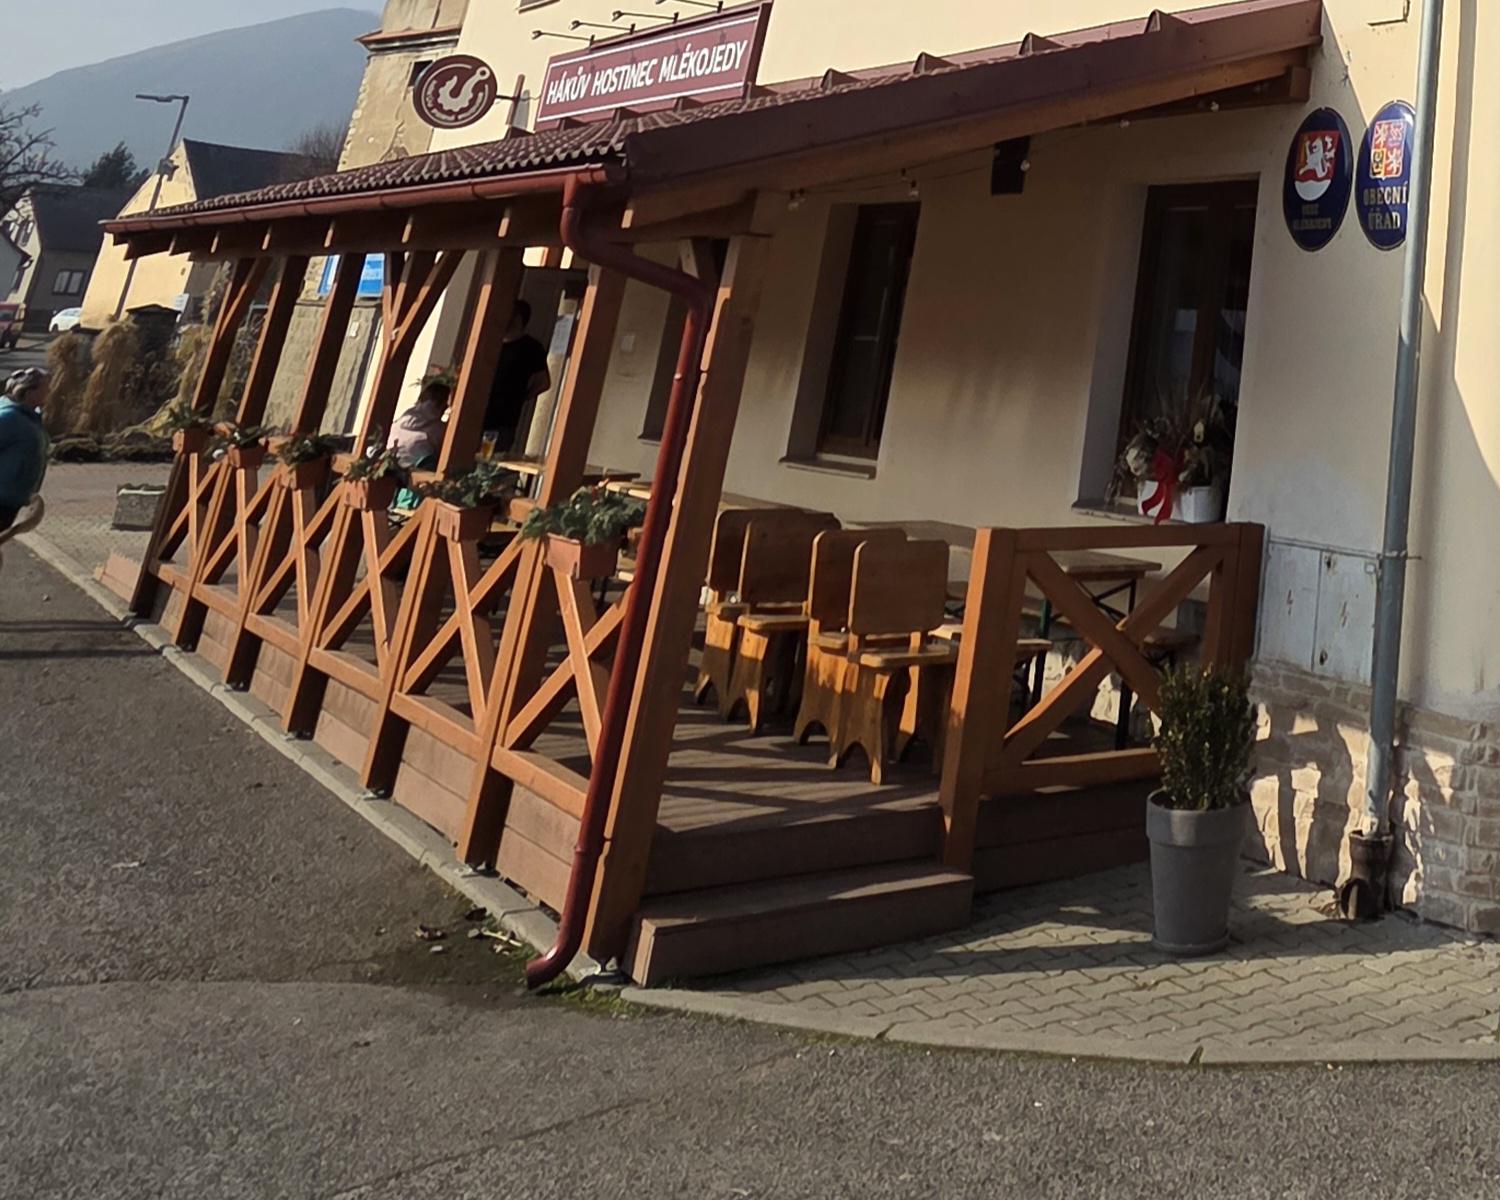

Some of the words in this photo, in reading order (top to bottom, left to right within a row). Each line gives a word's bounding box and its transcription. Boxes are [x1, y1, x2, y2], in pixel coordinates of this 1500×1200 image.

[546, 66, 592, 105] HÁKŮV
[591, 58, 658, 97] HOSTINEC
[658, 40, 748, 83] MLÉKOJEDY
[1363, 181, 1408, 206] OBECNÍ
[1367, 207, 1400, 231] ÚŘAD
